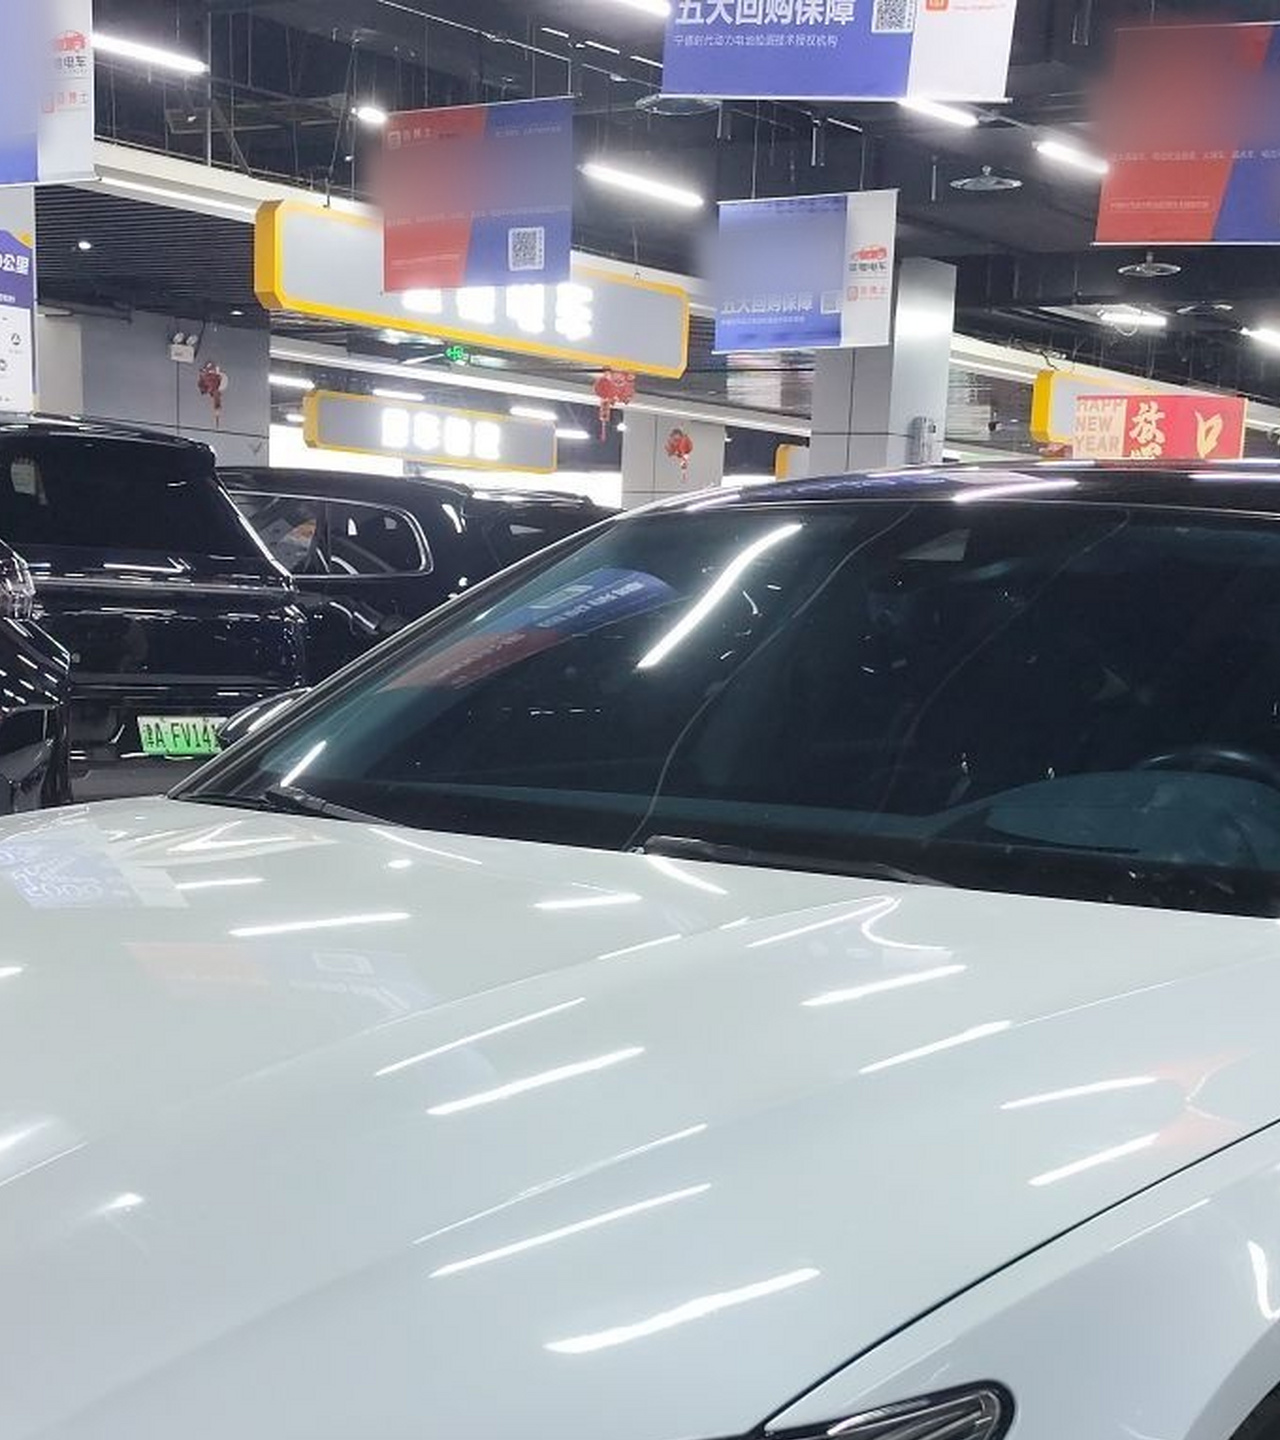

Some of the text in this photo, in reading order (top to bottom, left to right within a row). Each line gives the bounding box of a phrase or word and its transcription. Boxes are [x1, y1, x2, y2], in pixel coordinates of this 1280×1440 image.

[675, 0, 856, 26] 五大回购保障
[1075, 415, 1113, 432] NEW
[1074, 435, 1121, 452] YEAR
